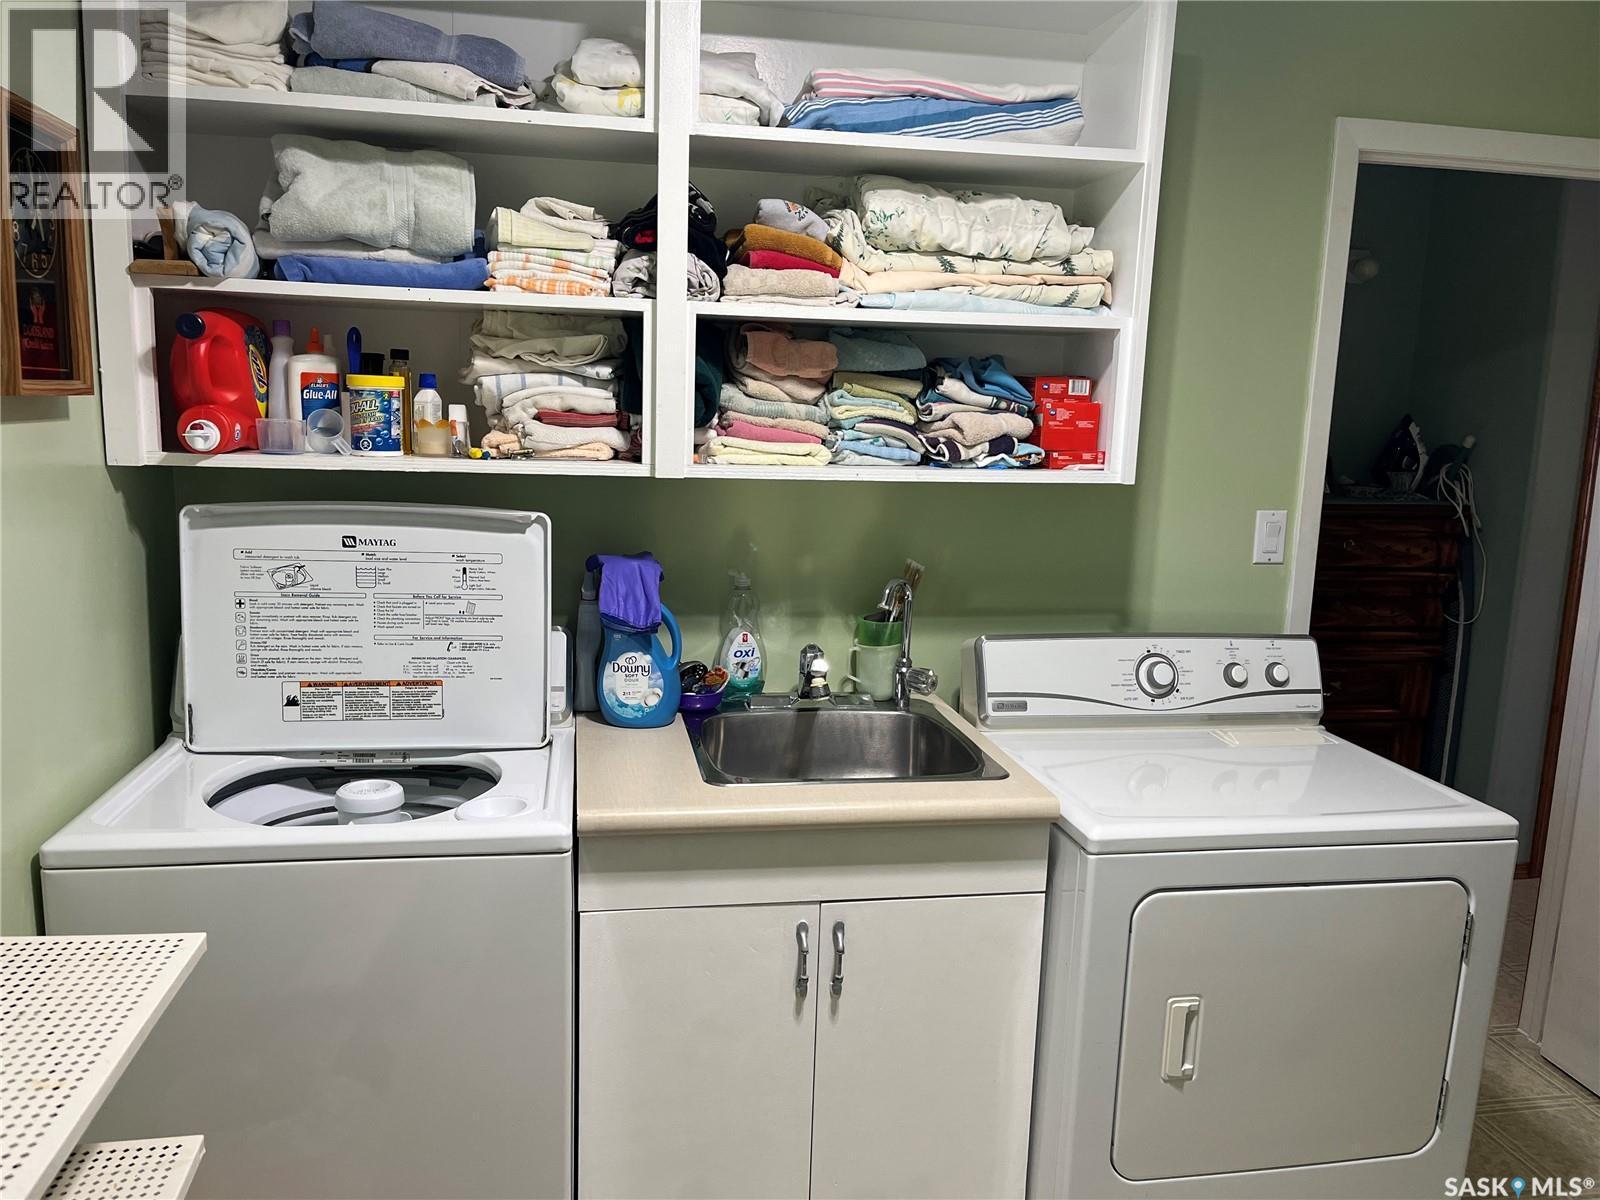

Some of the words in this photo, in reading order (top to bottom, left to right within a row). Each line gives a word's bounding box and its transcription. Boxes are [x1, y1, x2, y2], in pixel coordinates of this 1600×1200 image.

[303, 389, 338, 400] Glue-All
[358, 538, 397, 547] MAYTAG
[734, 648, 756, 658] oxi
[612, 662, 650, 676] Downy
